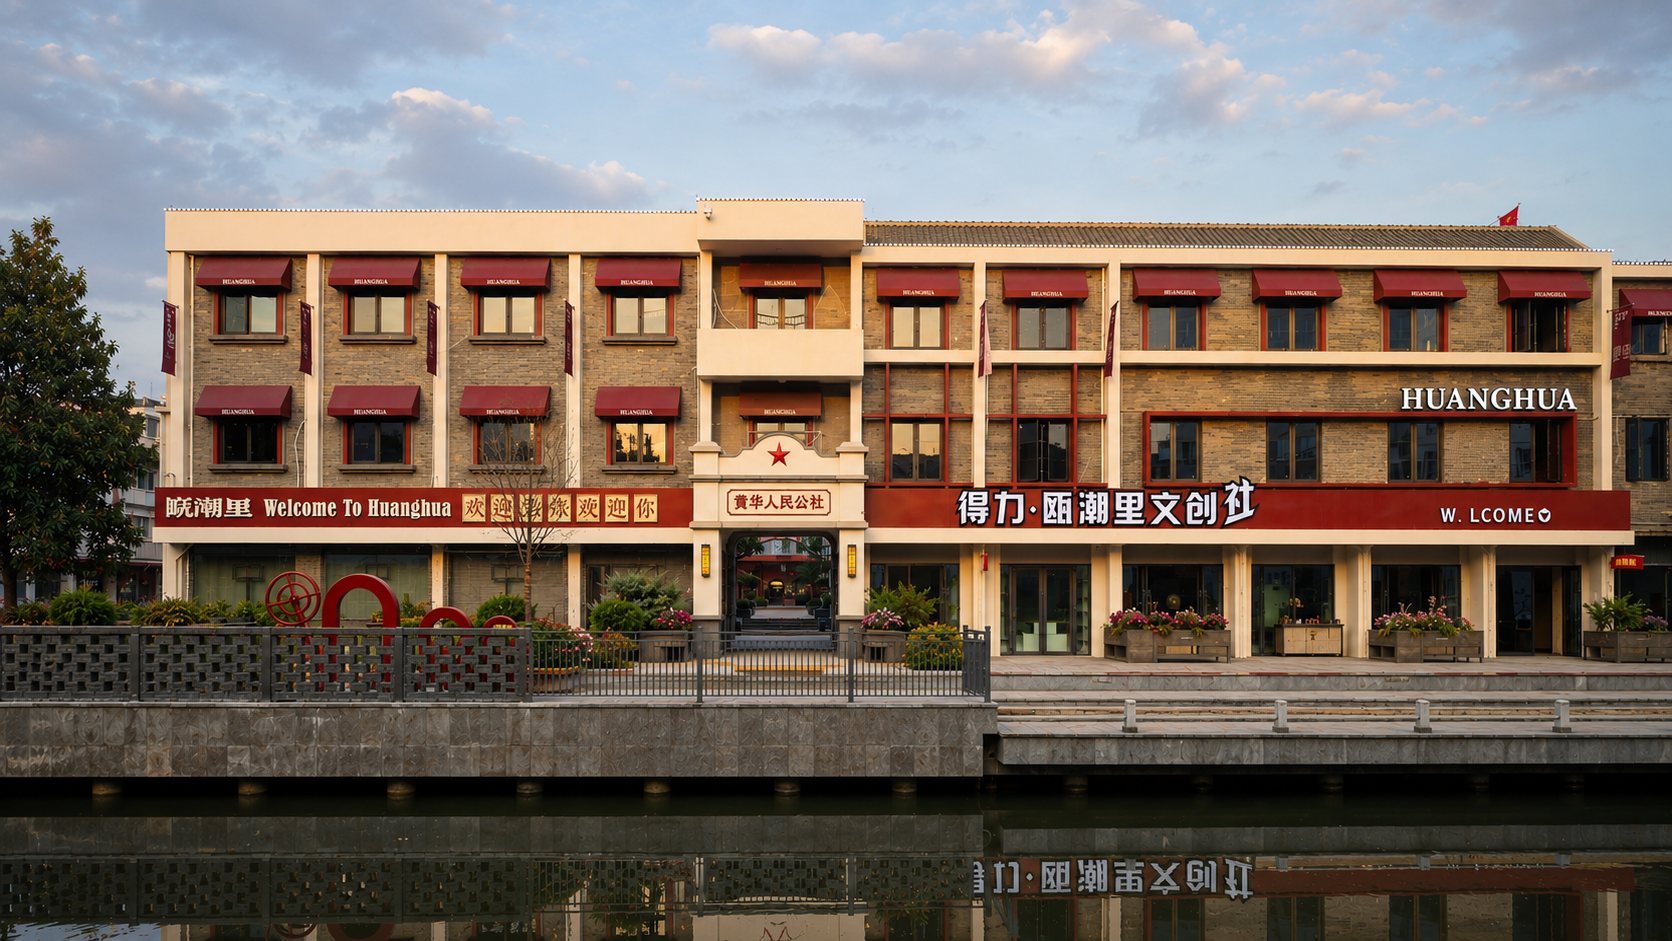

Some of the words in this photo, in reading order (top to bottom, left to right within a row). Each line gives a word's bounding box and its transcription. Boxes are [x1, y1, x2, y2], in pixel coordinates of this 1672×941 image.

[1401, 387, 1578, 411] HUANGHUA
[263, 498, 337, 517] Welcome
[343, 498, 362, 517] To
[367, 498, 452, 520] Huanghua
[734, 494, 824, 510] 黄华人民公社
